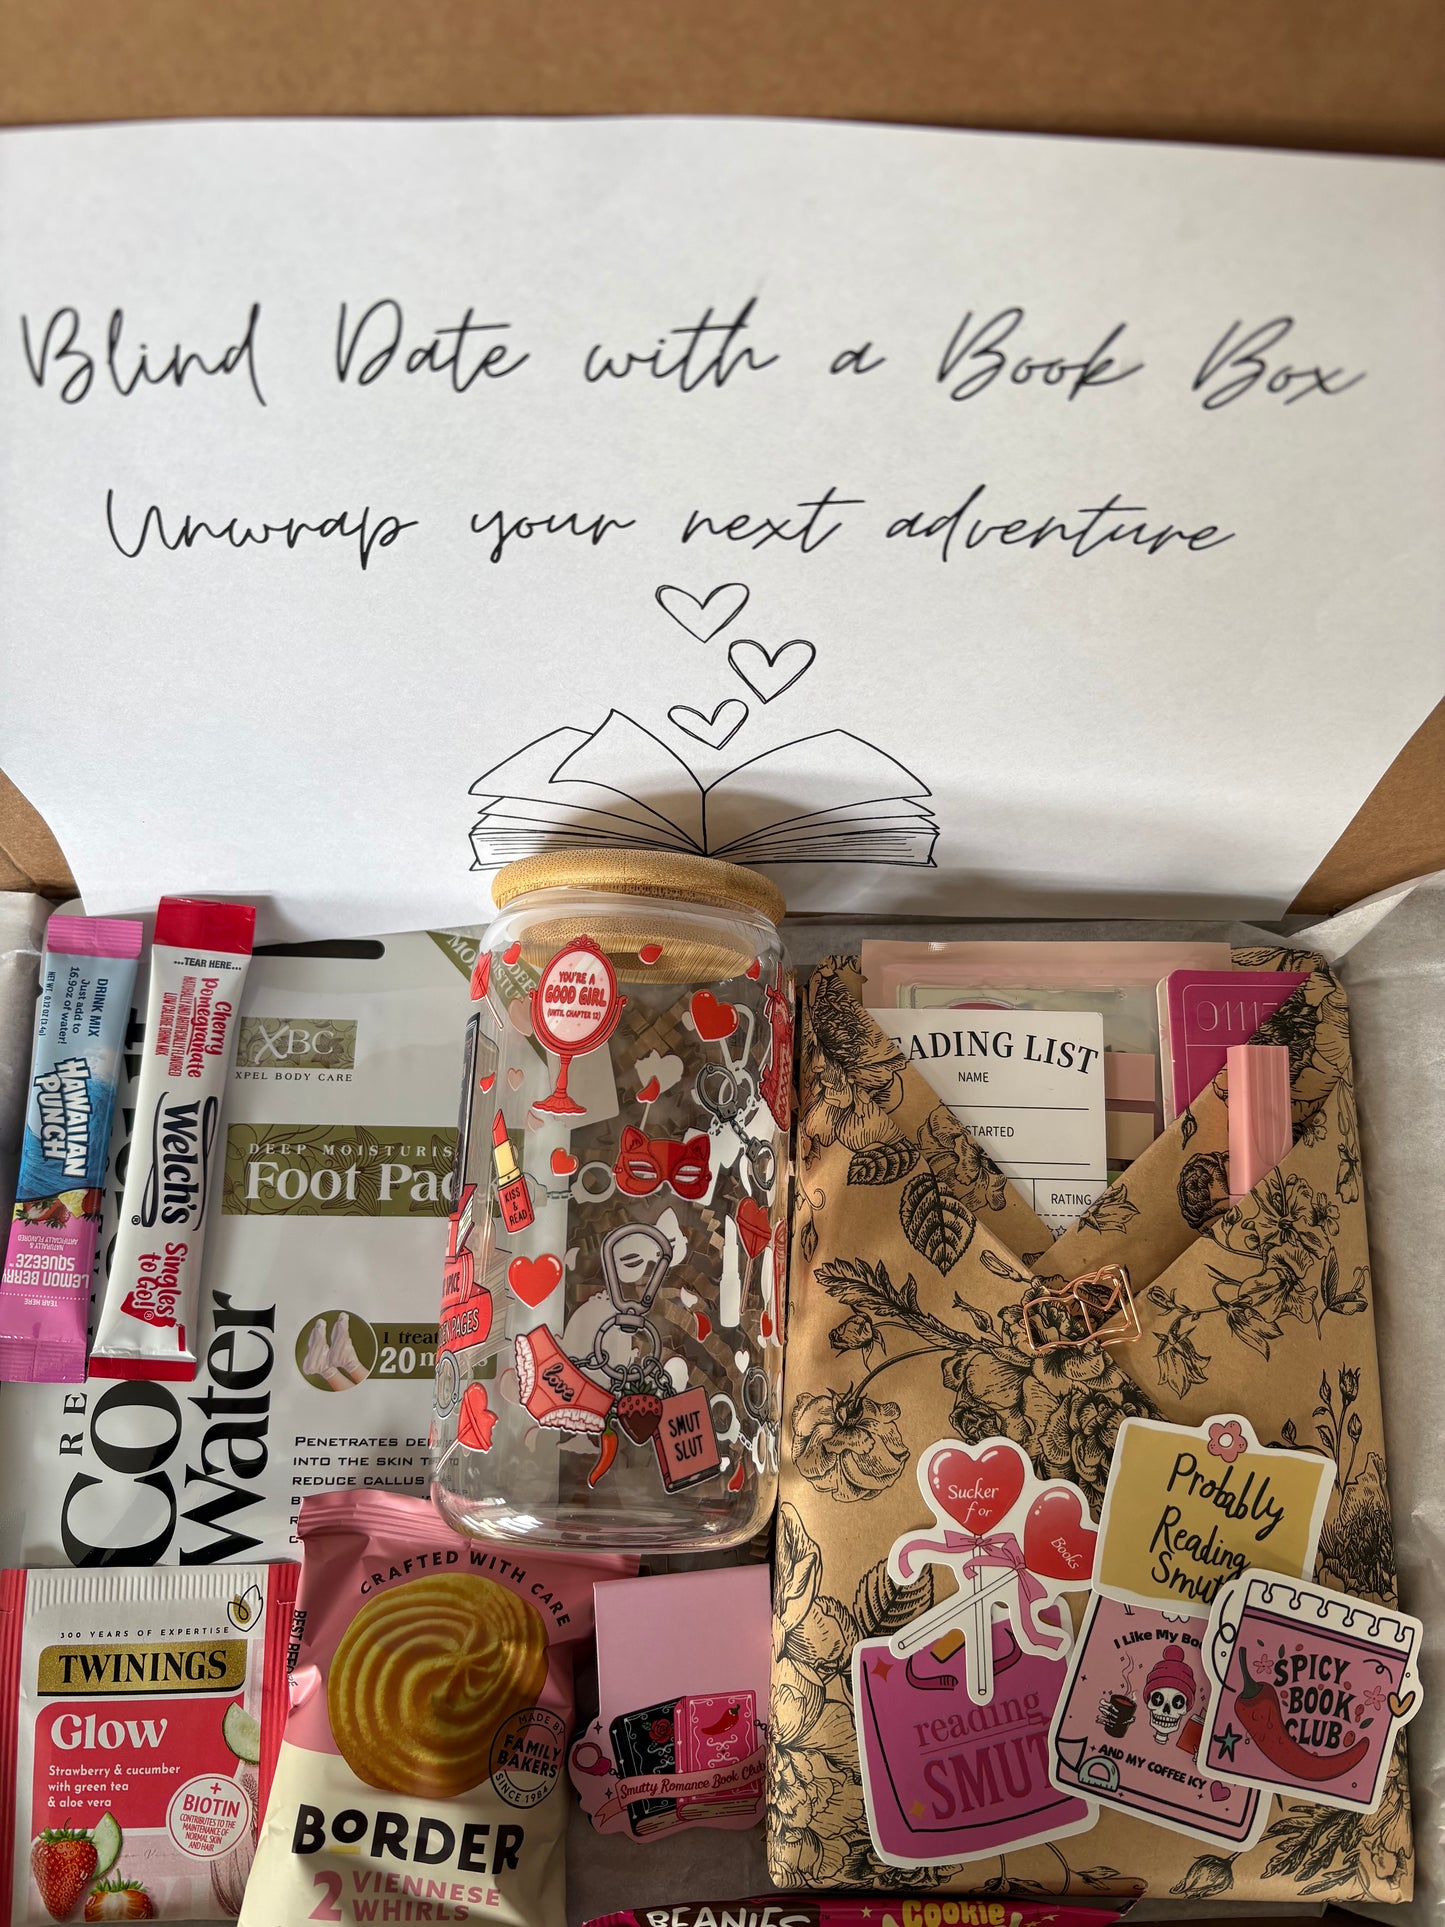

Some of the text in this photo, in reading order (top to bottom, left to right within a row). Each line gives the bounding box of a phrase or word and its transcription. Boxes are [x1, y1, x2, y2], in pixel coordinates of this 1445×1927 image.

[22, 297, 1368, 410] Blind Date with a Book Box
[106, 484, 1236, 570] Unwrap your next adventure
[47, 971, 56, 982] NET
[559, 971, 596, 985] YOU'RE A
[57, 966, 80, 1044] 16.9oz of water!
[72, 979, 91, 1034] Just add to
[88, 978, 108, 1037] DRINK MIX
[545, 984, 607, 1007] GOOD GIRL
[204, 1001, 233, 1056] Cherry
[566, 1010, 591, 1019] CHAPTER
[254, 1024, 335, 1065] XBC
[1023, 1034, 1099, 1074] LIST
[235, 1071, 353, 1082] XPEL BODY CARE
[958, 1071, 989, 1083] NAME
[33, 1070, 68, 1161] PUNCH
[54, 1057, 93, 1178] HAWAIIAN
[965, 1125, 1015, 1137] STARTED
[162, 1099, 202, 1225] Welch's
[250, 1143, 454, 1158] DEEP MOISTURIS
[245, 1160, 361, 1200] Foot
[504, 1186, 521, 1203] KISS
[512, 1203, 519, 1211] &
[1051, 1193, 1092, 1206] RATING
[509, 1209, 528, 1226] READ
[134, 1251, 162, 1307] to Go!
[156, 1241, 189, 1316] Singles
[24, 1298, 58, 1307] TEAR HERE
[451, 1308, 480, 1341] PAGES
[379, 1346, 417, 1375] 20
[542, 1361, 576, 1403] love
[179, 1289, 277, 1566] Water
[669, 1410, 701, 1438] SMUT
[293, 1457, 330, 1466] INTO
[338, 1457, 369, 1466] THE
[376, 1457, 413, 1466] SKIN
[675, 1435, 704, 1462] SLUT
[292, 1476, 425, 1486] REDUCE CALLUS
[947, 1478, 1000, 1500] Sucker
[1167, 1453, 1284, 1541] Probably
[1049, 1537, 1080, 1570] Books
[1149, 1504, 1251, 1575] Reading
[360, 1550, 571, 1628] CRAFTED WITH CARE
[60, 1626, 230, 1639] 300 YEARS OF EXPERTISE
[291, 1610, 307, 1641] BEST
[1113, 1638, 1121, 1650] I
[1122, 1629, 1153, 1646] Like
[1155, 1629, 1179, 1644] My
[58, 1649, 227, 1684] TWININGS
[1274, 1653, 1352, 1687] SPICY
[912, 1691, 1040, 1748] reading
[1288, 1686, 1357, 1723] BOOK
[51, 1713, 168, 1750] Glow
[518, 1712, 564, 1736] MADE BY
[1284, 1717, 1342, 1750] CLUB
[503, 1733, 562, 1762] FAMILY
[49, 1762, 181, 1778] Strawberry & cucumber
[497, 1749, 559, 1779] BAKERS
[1097, 1743, 1208, 1790] AND MY COFFEE ICY
[48, 1780, 129, 1794] with green tea
[495, 1772, 548, 1804] SINCE 1984
[619, 1760, 767, 1800] Smutty Romance Book Club
[47, 1796, 112, 1808] & aloe vera
[183, 1793, 241, 1818] BIOTIN
[180, 1813, 216, 1826] CONTRIBUTES
[188, 1841, 215, 1852] AND HAIR
[292, 1803, 525, 1876] BORDER
[308, 1870, 344, 1923] 2
[352, 1870, 502, 1908] VIENNESE
[353, 1897, 470, 1923] WHIRLS
[901, 1899, 1006, 1927] Cookie
